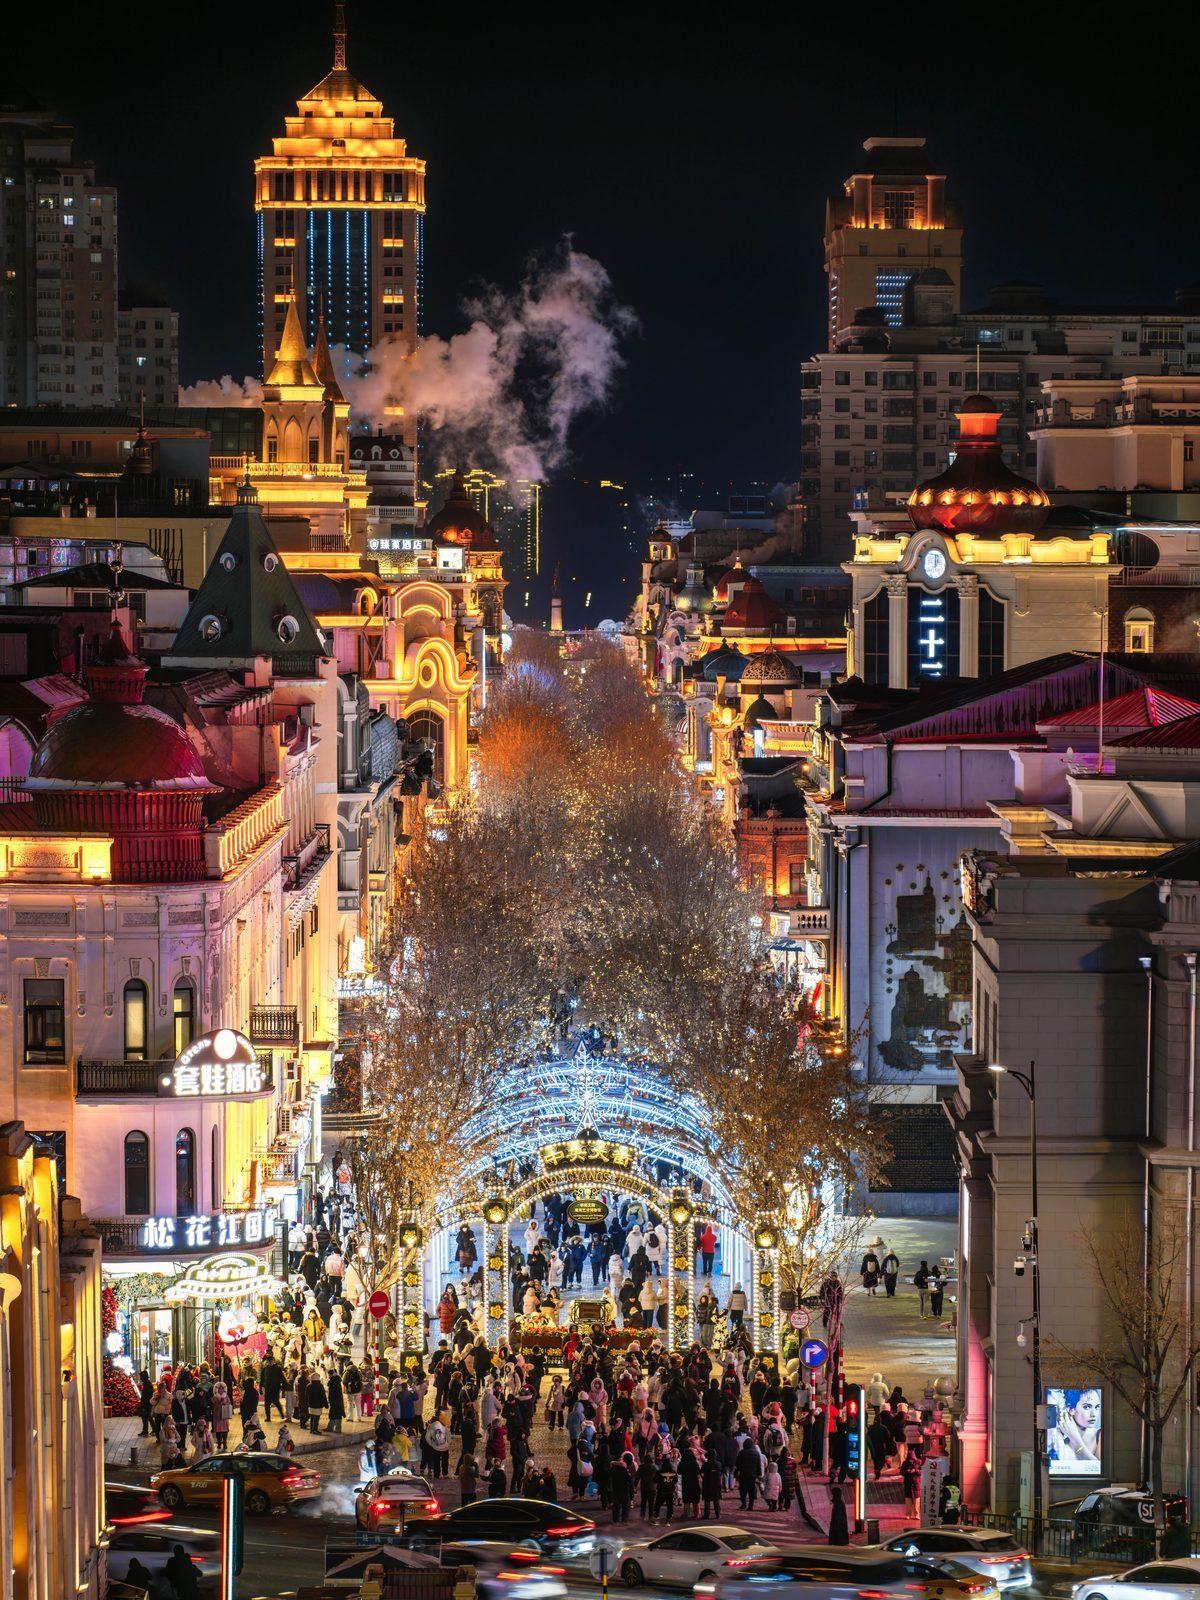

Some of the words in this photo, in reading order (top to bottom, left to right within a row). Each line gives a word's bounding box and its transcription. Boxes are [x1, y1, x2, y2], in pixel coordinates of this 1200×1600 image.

[174, 1063, 261, 1096] 套娃酒店
[544, 1148, 634, 1167] 中央大街
